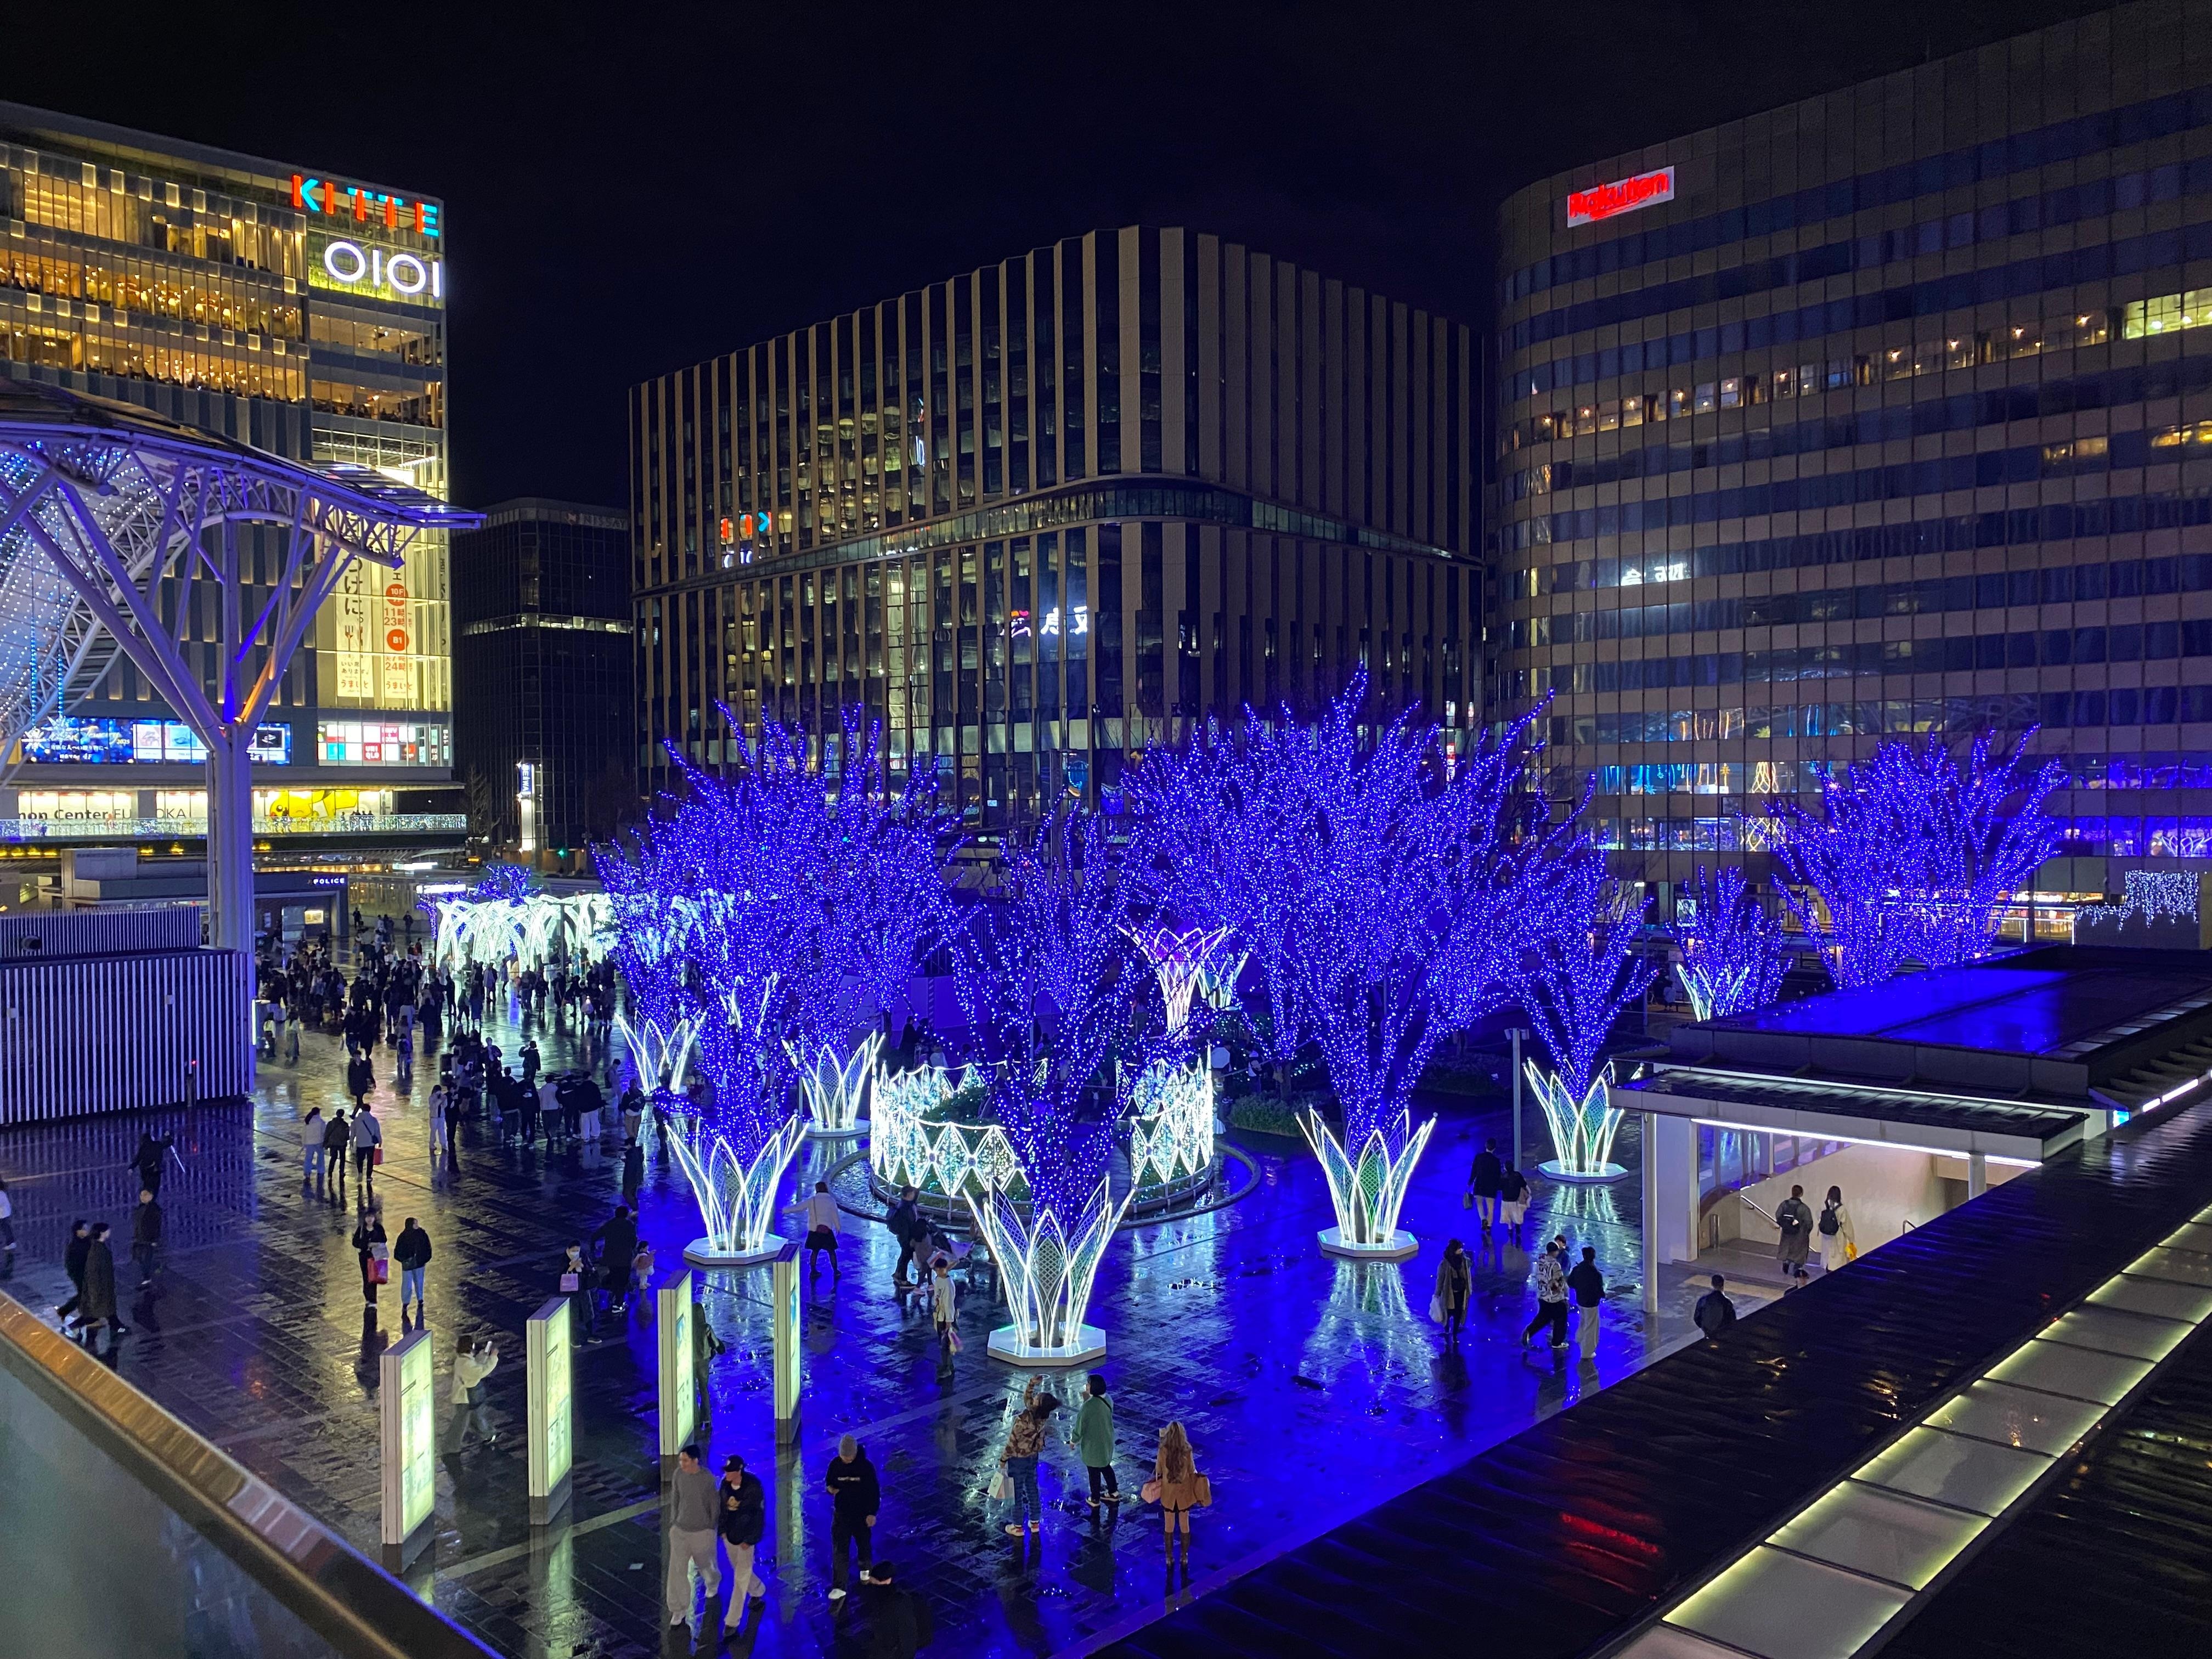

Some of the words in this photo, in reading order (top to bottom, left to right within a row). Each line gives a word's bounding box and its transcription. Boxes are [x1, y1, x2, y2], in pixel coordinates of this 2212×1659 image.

[1570, 173, 1669, 219] Rakuten
[291, 174, 439, 238] KITTE
[584, 514, 624, 529] NISSAY
[392, 636, 402, 645] B1
[54, 809, 108, 820] Center
